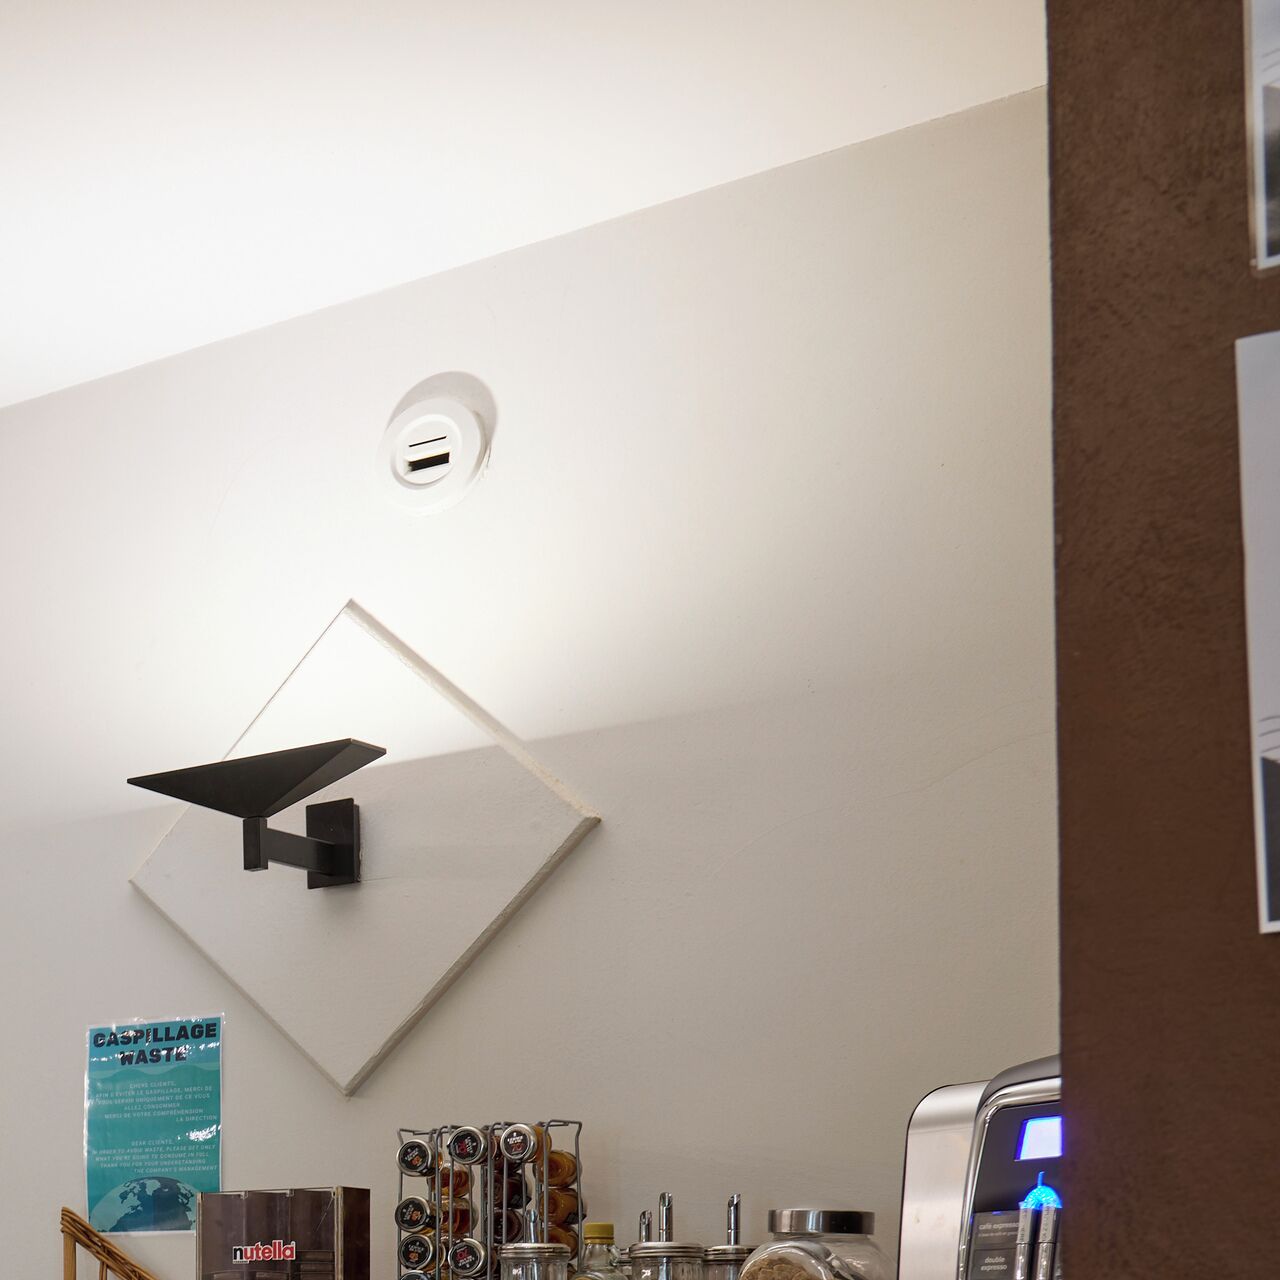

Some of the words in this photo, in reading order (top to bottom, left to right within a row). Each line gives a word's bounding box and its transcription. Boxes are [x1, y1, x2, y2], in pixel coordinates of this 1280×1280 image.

[94, 1023, 216, 1048] GASPILLAGE
[120, 1047, 186, 1065] WASTE
[979, 1222, 991, 1230] café
[993, 1222, 1019, 1230] expresso
[233, 1240, 295, 1260] nutella
[981, 1264, 1007, 1272] expresso
